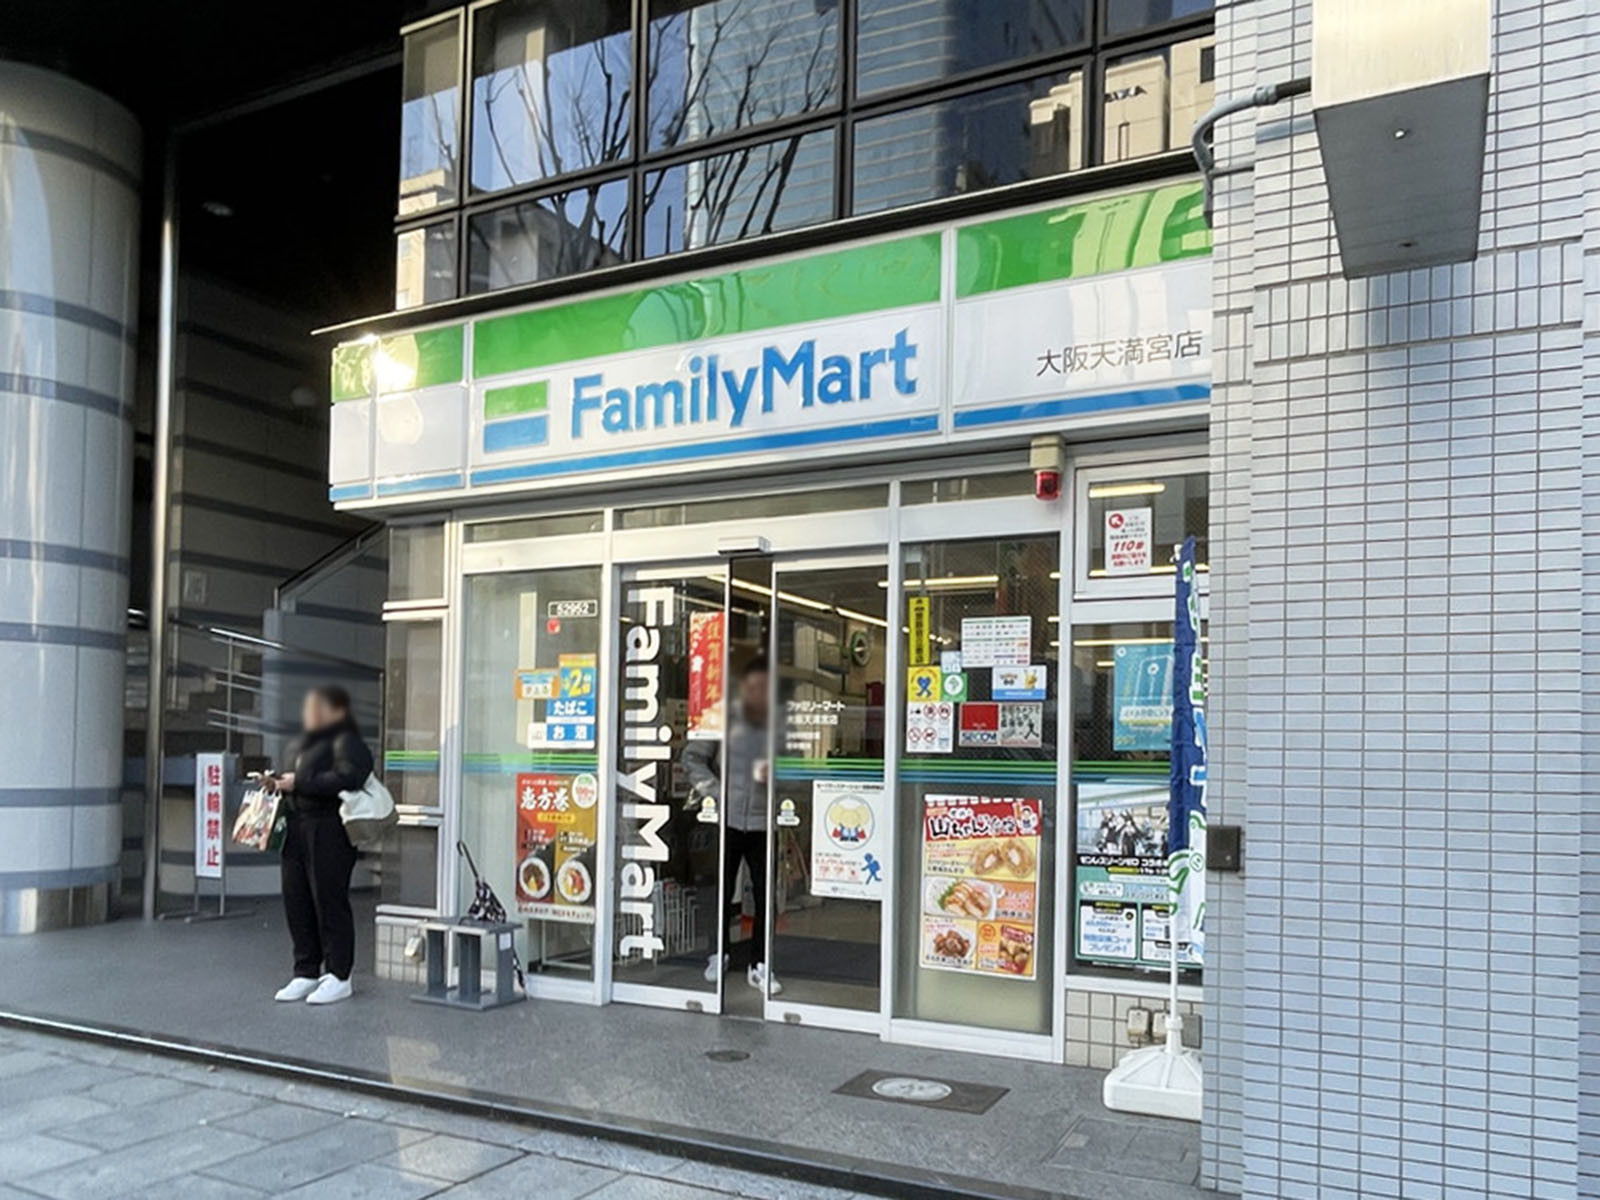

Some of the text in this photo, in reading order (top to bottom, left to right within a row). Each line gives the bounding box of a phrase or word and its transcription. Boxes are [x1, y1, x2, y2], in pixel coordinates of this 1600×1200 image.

[571, 326, 918, 440] FamilyMart
[1036, 330, 1203, 377] 大阪天満宮店
[553, 700, 588, 716] たばこ
[206, 765, 222, 867] 駐輪禁止
[617, 586, 674, 960] FamilyMart
